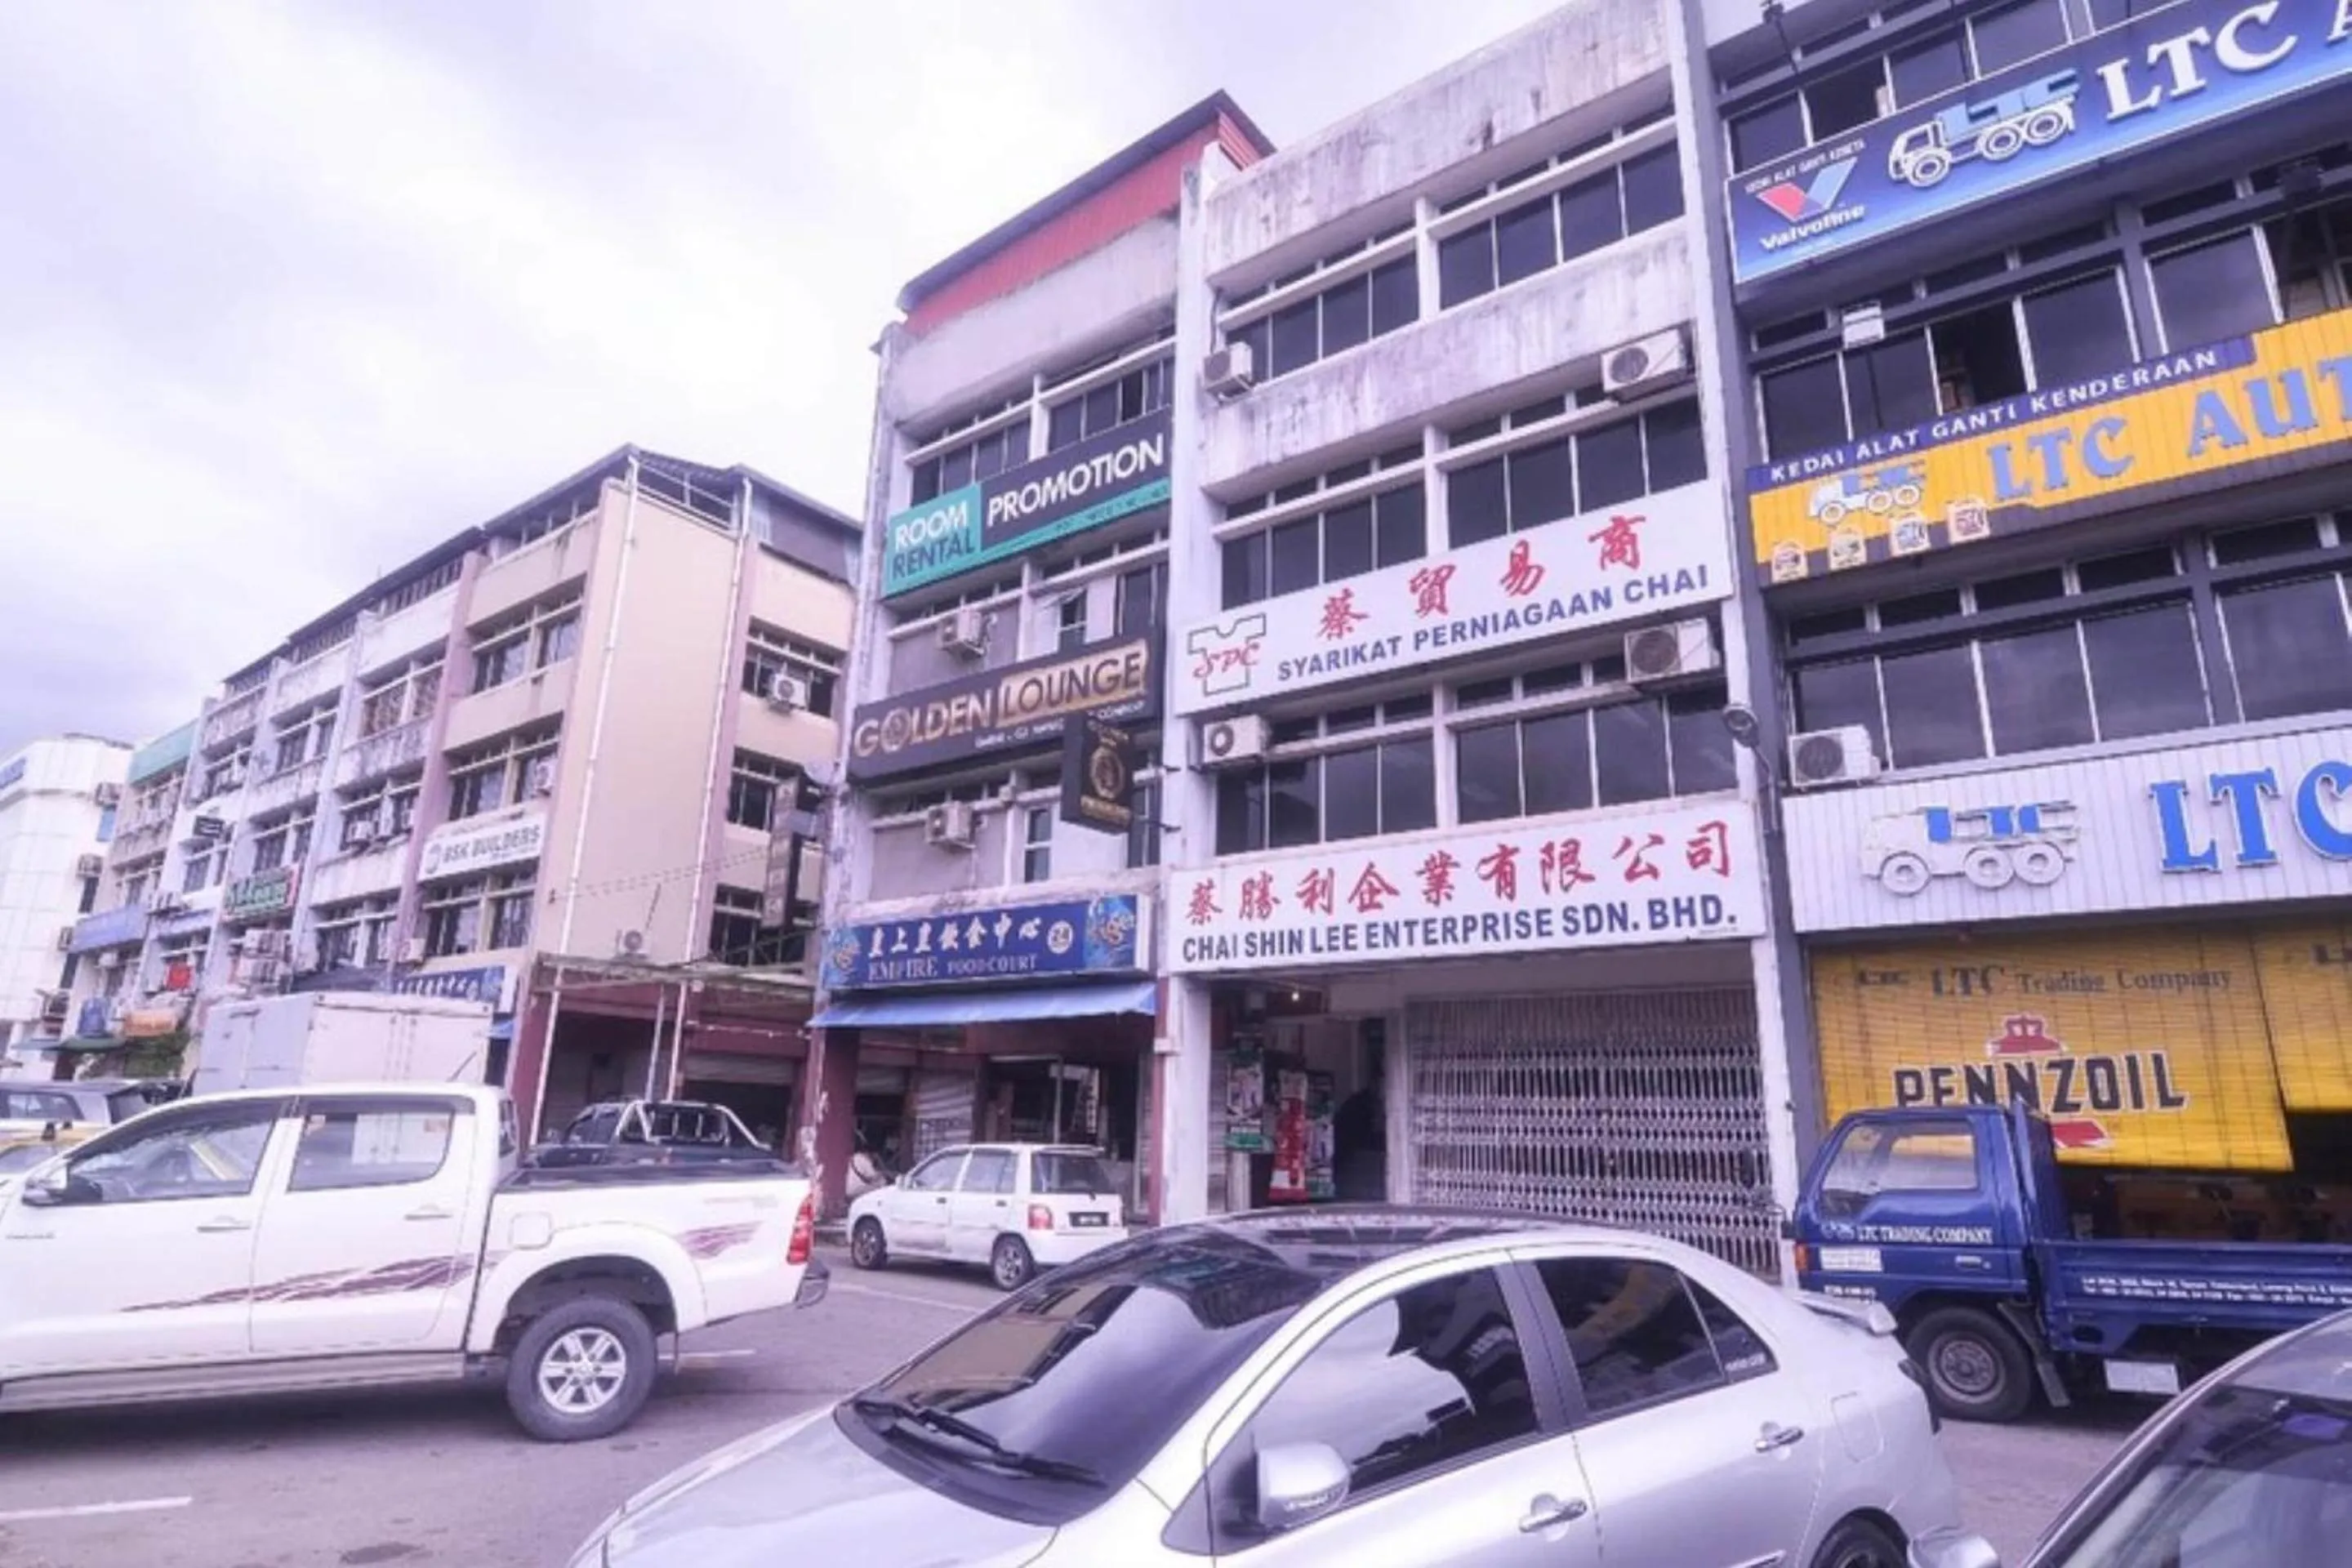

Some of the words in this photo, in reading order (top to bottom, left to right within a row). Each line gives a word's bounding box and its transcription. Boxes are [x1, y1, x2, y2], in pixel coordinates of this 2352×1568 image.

[2096, 1, 2298, 120] LTC
[1759, 204, 1866, 251] Valvoline
[1771, 450, 1845, 483] KEDAI
[1856, 430, 1919, 460] ALAT
[1931, 403, 2017, 439] GANTI
[2030, 350, 2217, 413] KENDERAAN
[987, 434, 1164, 528] PROMOTION
[1987, 416, 2135, 500] LTC
[892, 532, 976, 579] RENTAL
[895, 501, 969, 550] ROOM
[1278, 635, 1402, 682] SYARIKAT
[1414, 589, 1614, 652] PERNIAGAAN
[1624, 564, 1710, 606] CHAI
[854, 695, 992, 757] GOLDEN
[1004, 651, 1143, 715] LOUNGE
[472, 825, 541, 858] BUILDERS
[2149, 760, 2352, 874] LTC
[1183, 934, 1239, 964] CHAI
[1244, 929, 1304, 960] SHIN
[1309, 924, 1358, 953] LEE
[1365, 907, 1553, 949] ENTERPRISE
[1561, 902, 1641, 935] SDN.
[1650, 893, 1738, 930] BHD.
[868, 956, 938, 981] EMPIRE
[1931, 963, 2005, 996] LTC
[2017, 971, 2106, 992] Trading
[2117, 968, 2232, 994] Company
[1895, 1053, 2186, 1112] PENNZOIL
[1881, 1226, 1932, 1243] TRADING
[1934, 1227, 1994, 1245] COMPANY
